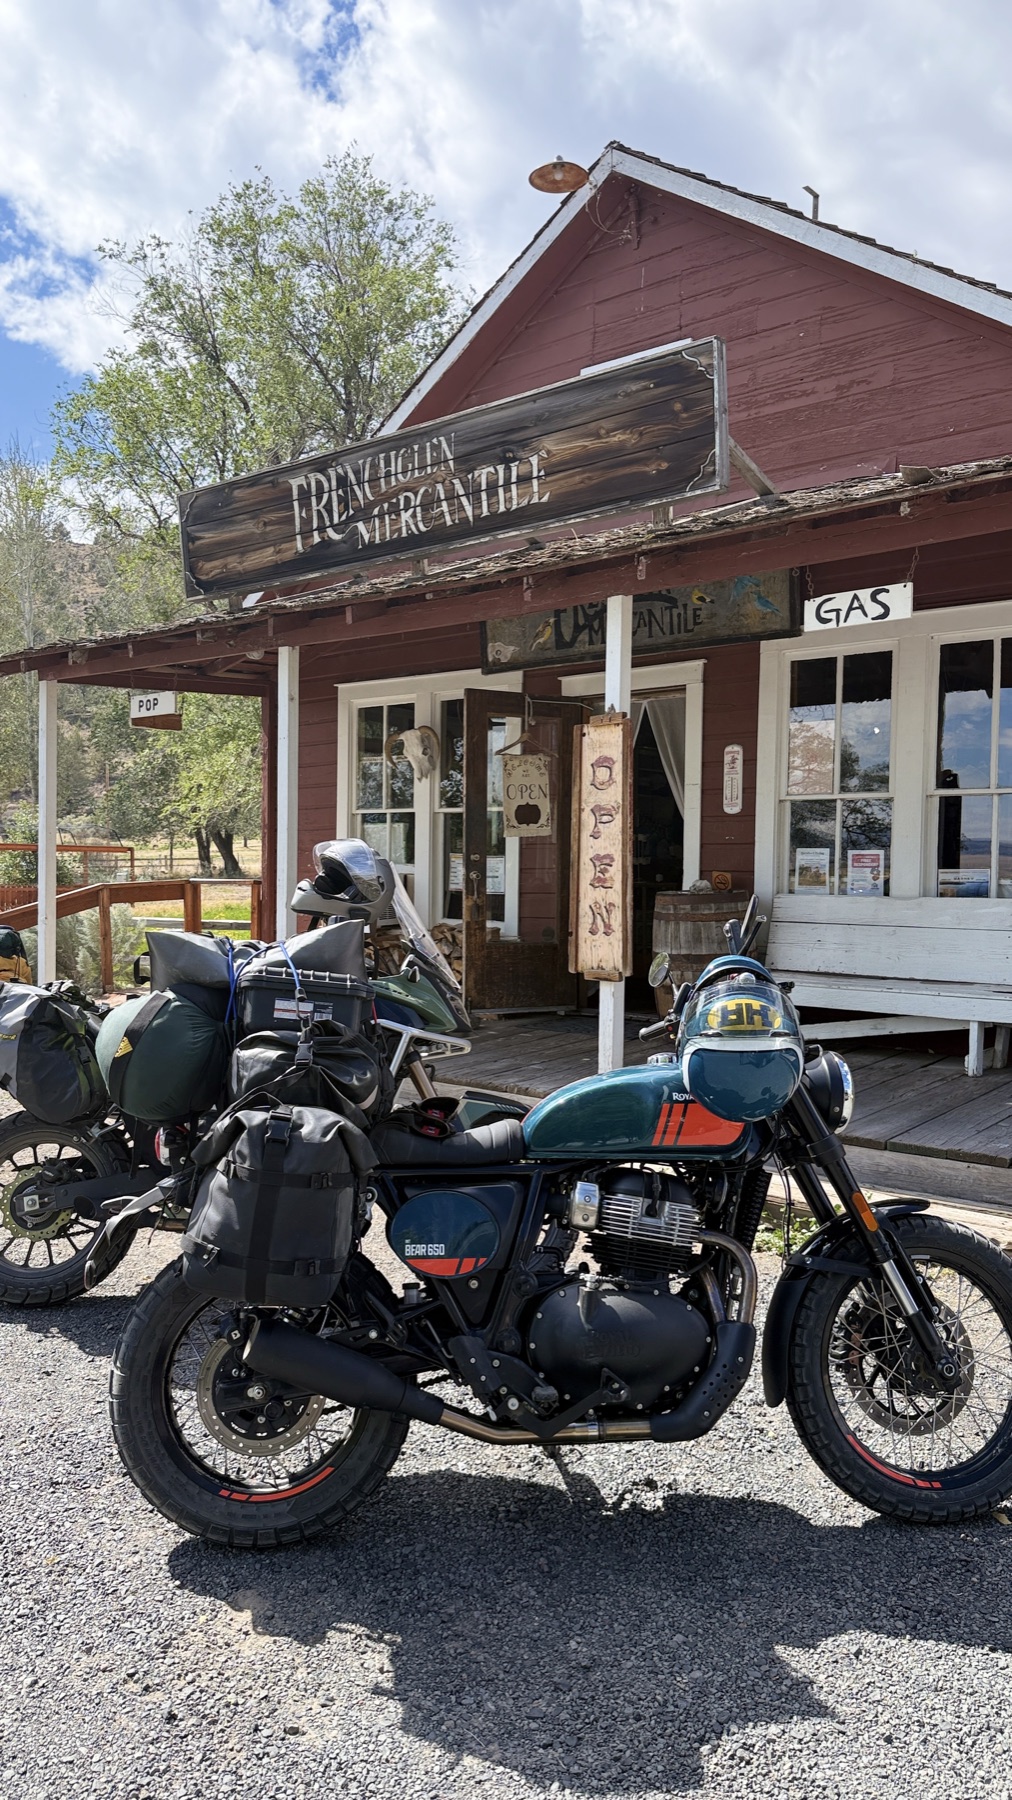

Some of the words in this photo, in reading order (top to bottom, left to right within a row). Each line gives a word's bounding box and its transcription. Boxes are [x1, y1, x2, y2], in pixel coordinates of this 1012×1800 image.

[288, 432, 456, 554] FRENCHGLEN
[354, 450, 550, 550] MERCANTILE
[815, 588, 890, 627] GAS
[138, 697, 159, 712] POP
[506, 783, 549, 800] OPEN
[672, 1092, 695, 1101] ROYA
[405, 1244, 427, 1256] BEAR
[427, 1244, 445, 1256] 650
